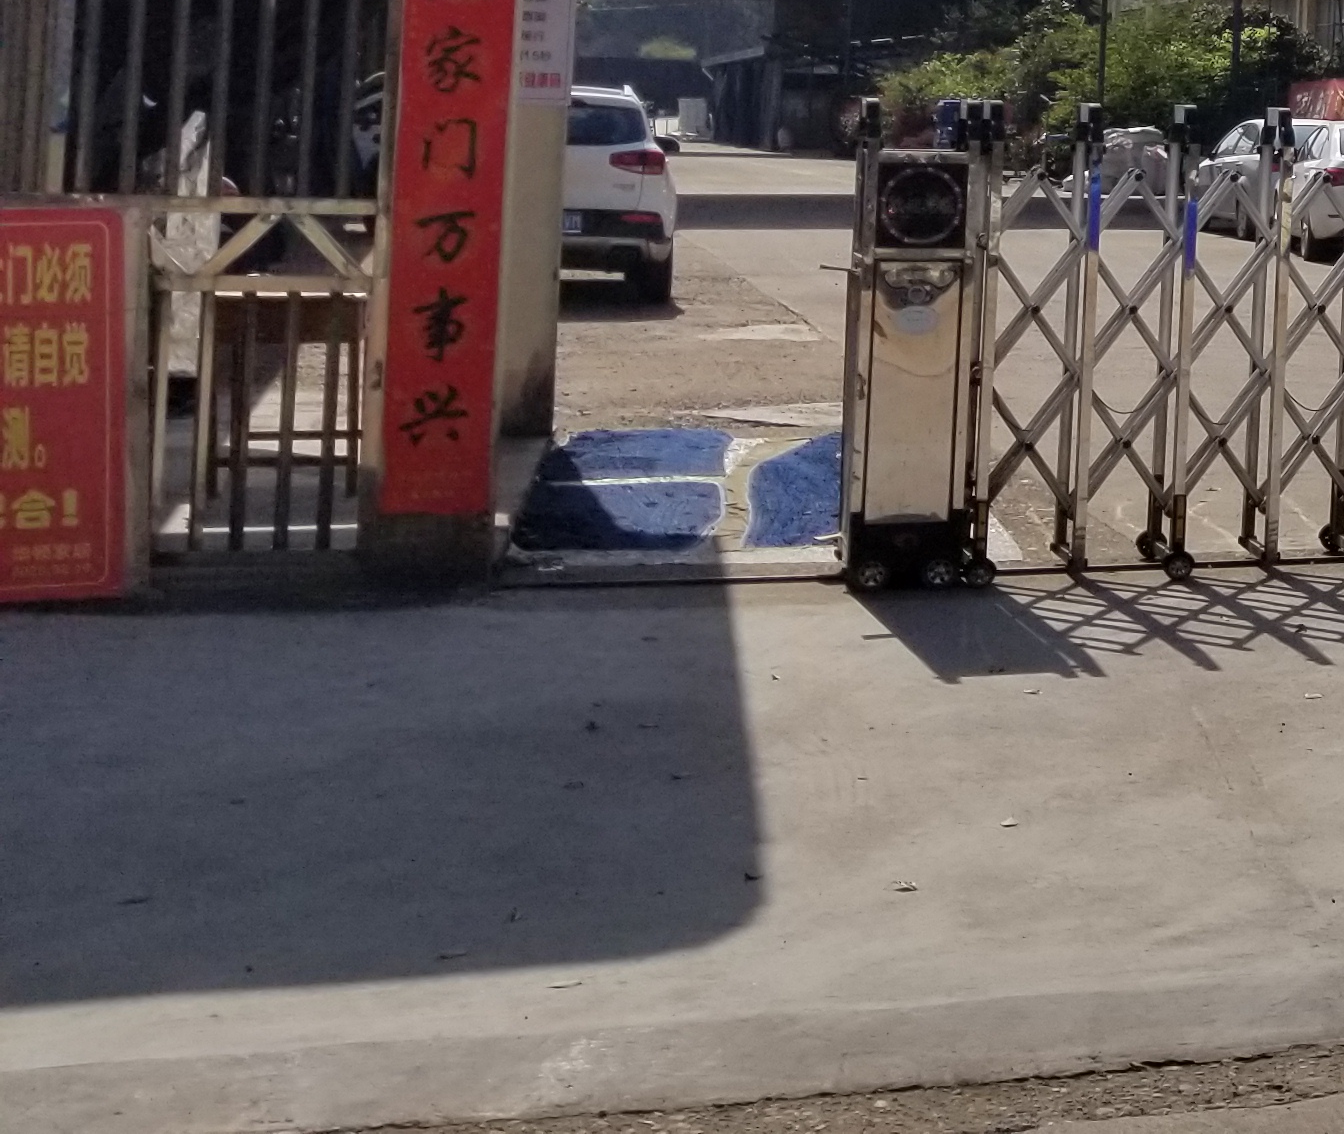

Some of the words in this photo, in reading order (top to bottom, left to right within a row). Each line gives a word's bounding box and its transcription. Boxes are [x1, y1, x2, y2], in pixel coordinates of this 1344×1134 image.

[0, 241, 93, 305] 门必须
[2, 320, 89, 388] 请自觉
[0, 487, 79, 530] 合！
